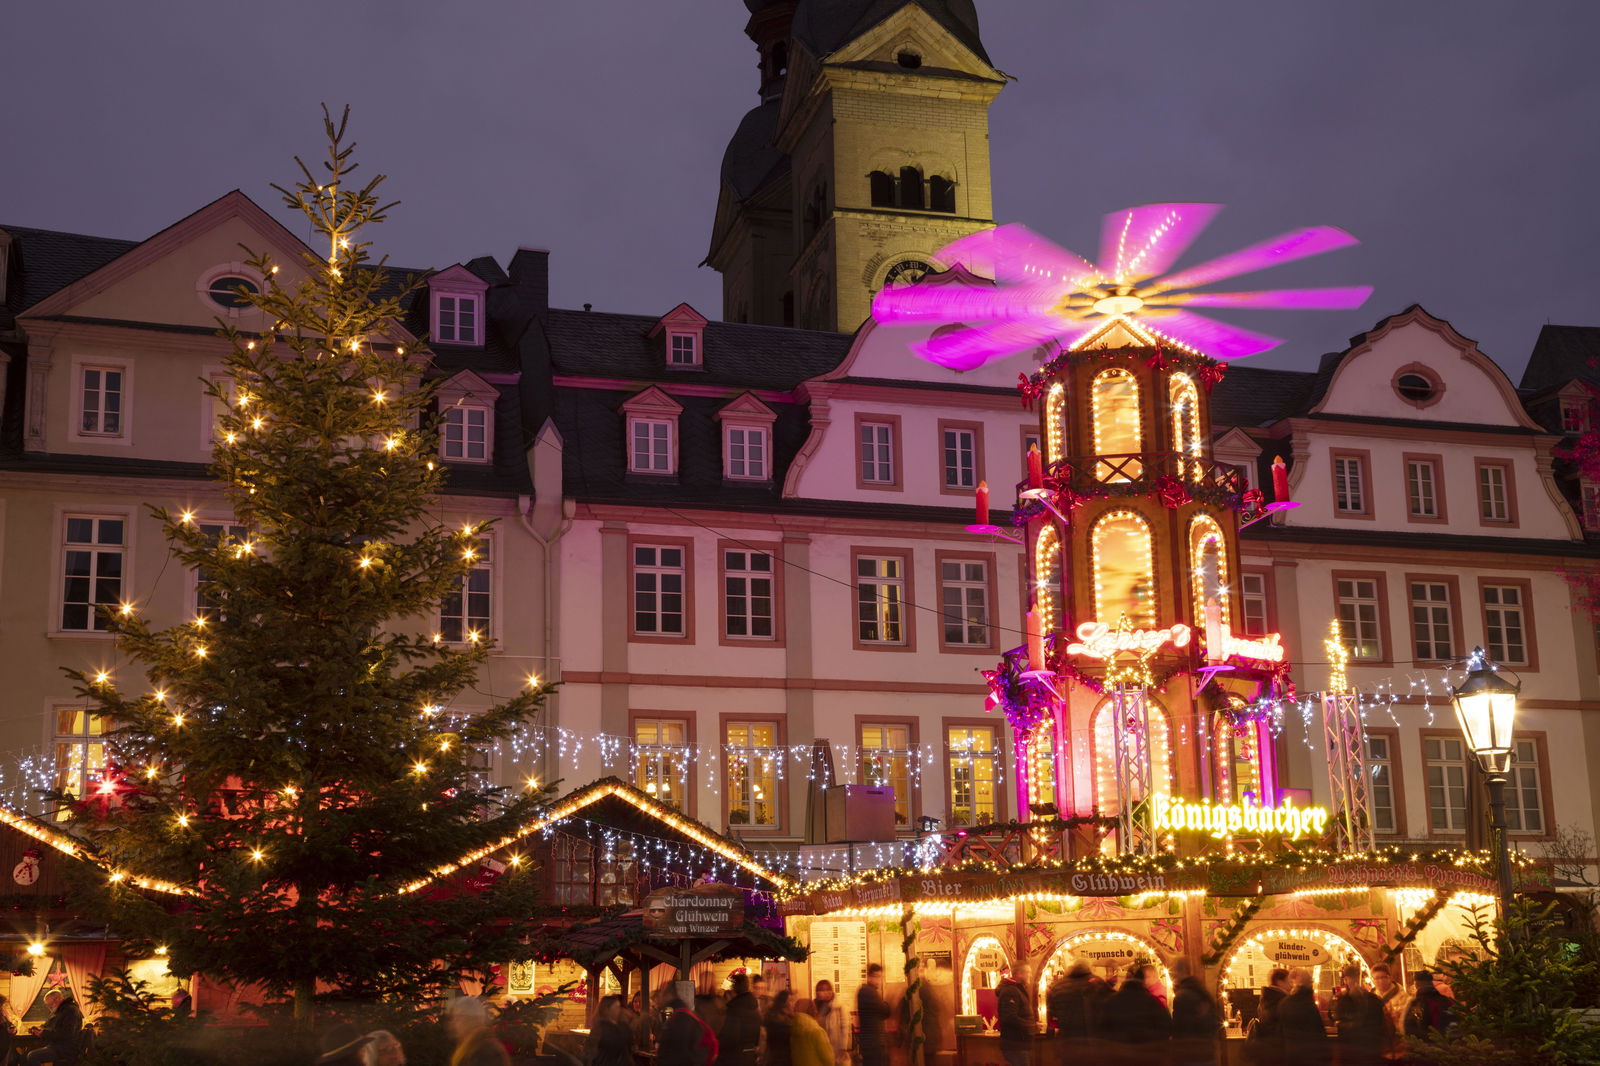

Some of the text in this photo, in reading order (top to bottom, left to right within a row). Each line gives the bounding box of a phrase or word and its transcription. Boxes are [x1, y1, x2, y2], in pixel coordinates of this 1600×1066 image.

[921, 879, 962, 897] Bier
[1071, 872, 1167, 893] Glühwein
[675, 910, 729, 922] Glühwein
[669, 924, 720, 934] vom Winzer
[1278, 942, 1307, 952] Kinder-
[1274, 951, 1310, 961] glühwein
